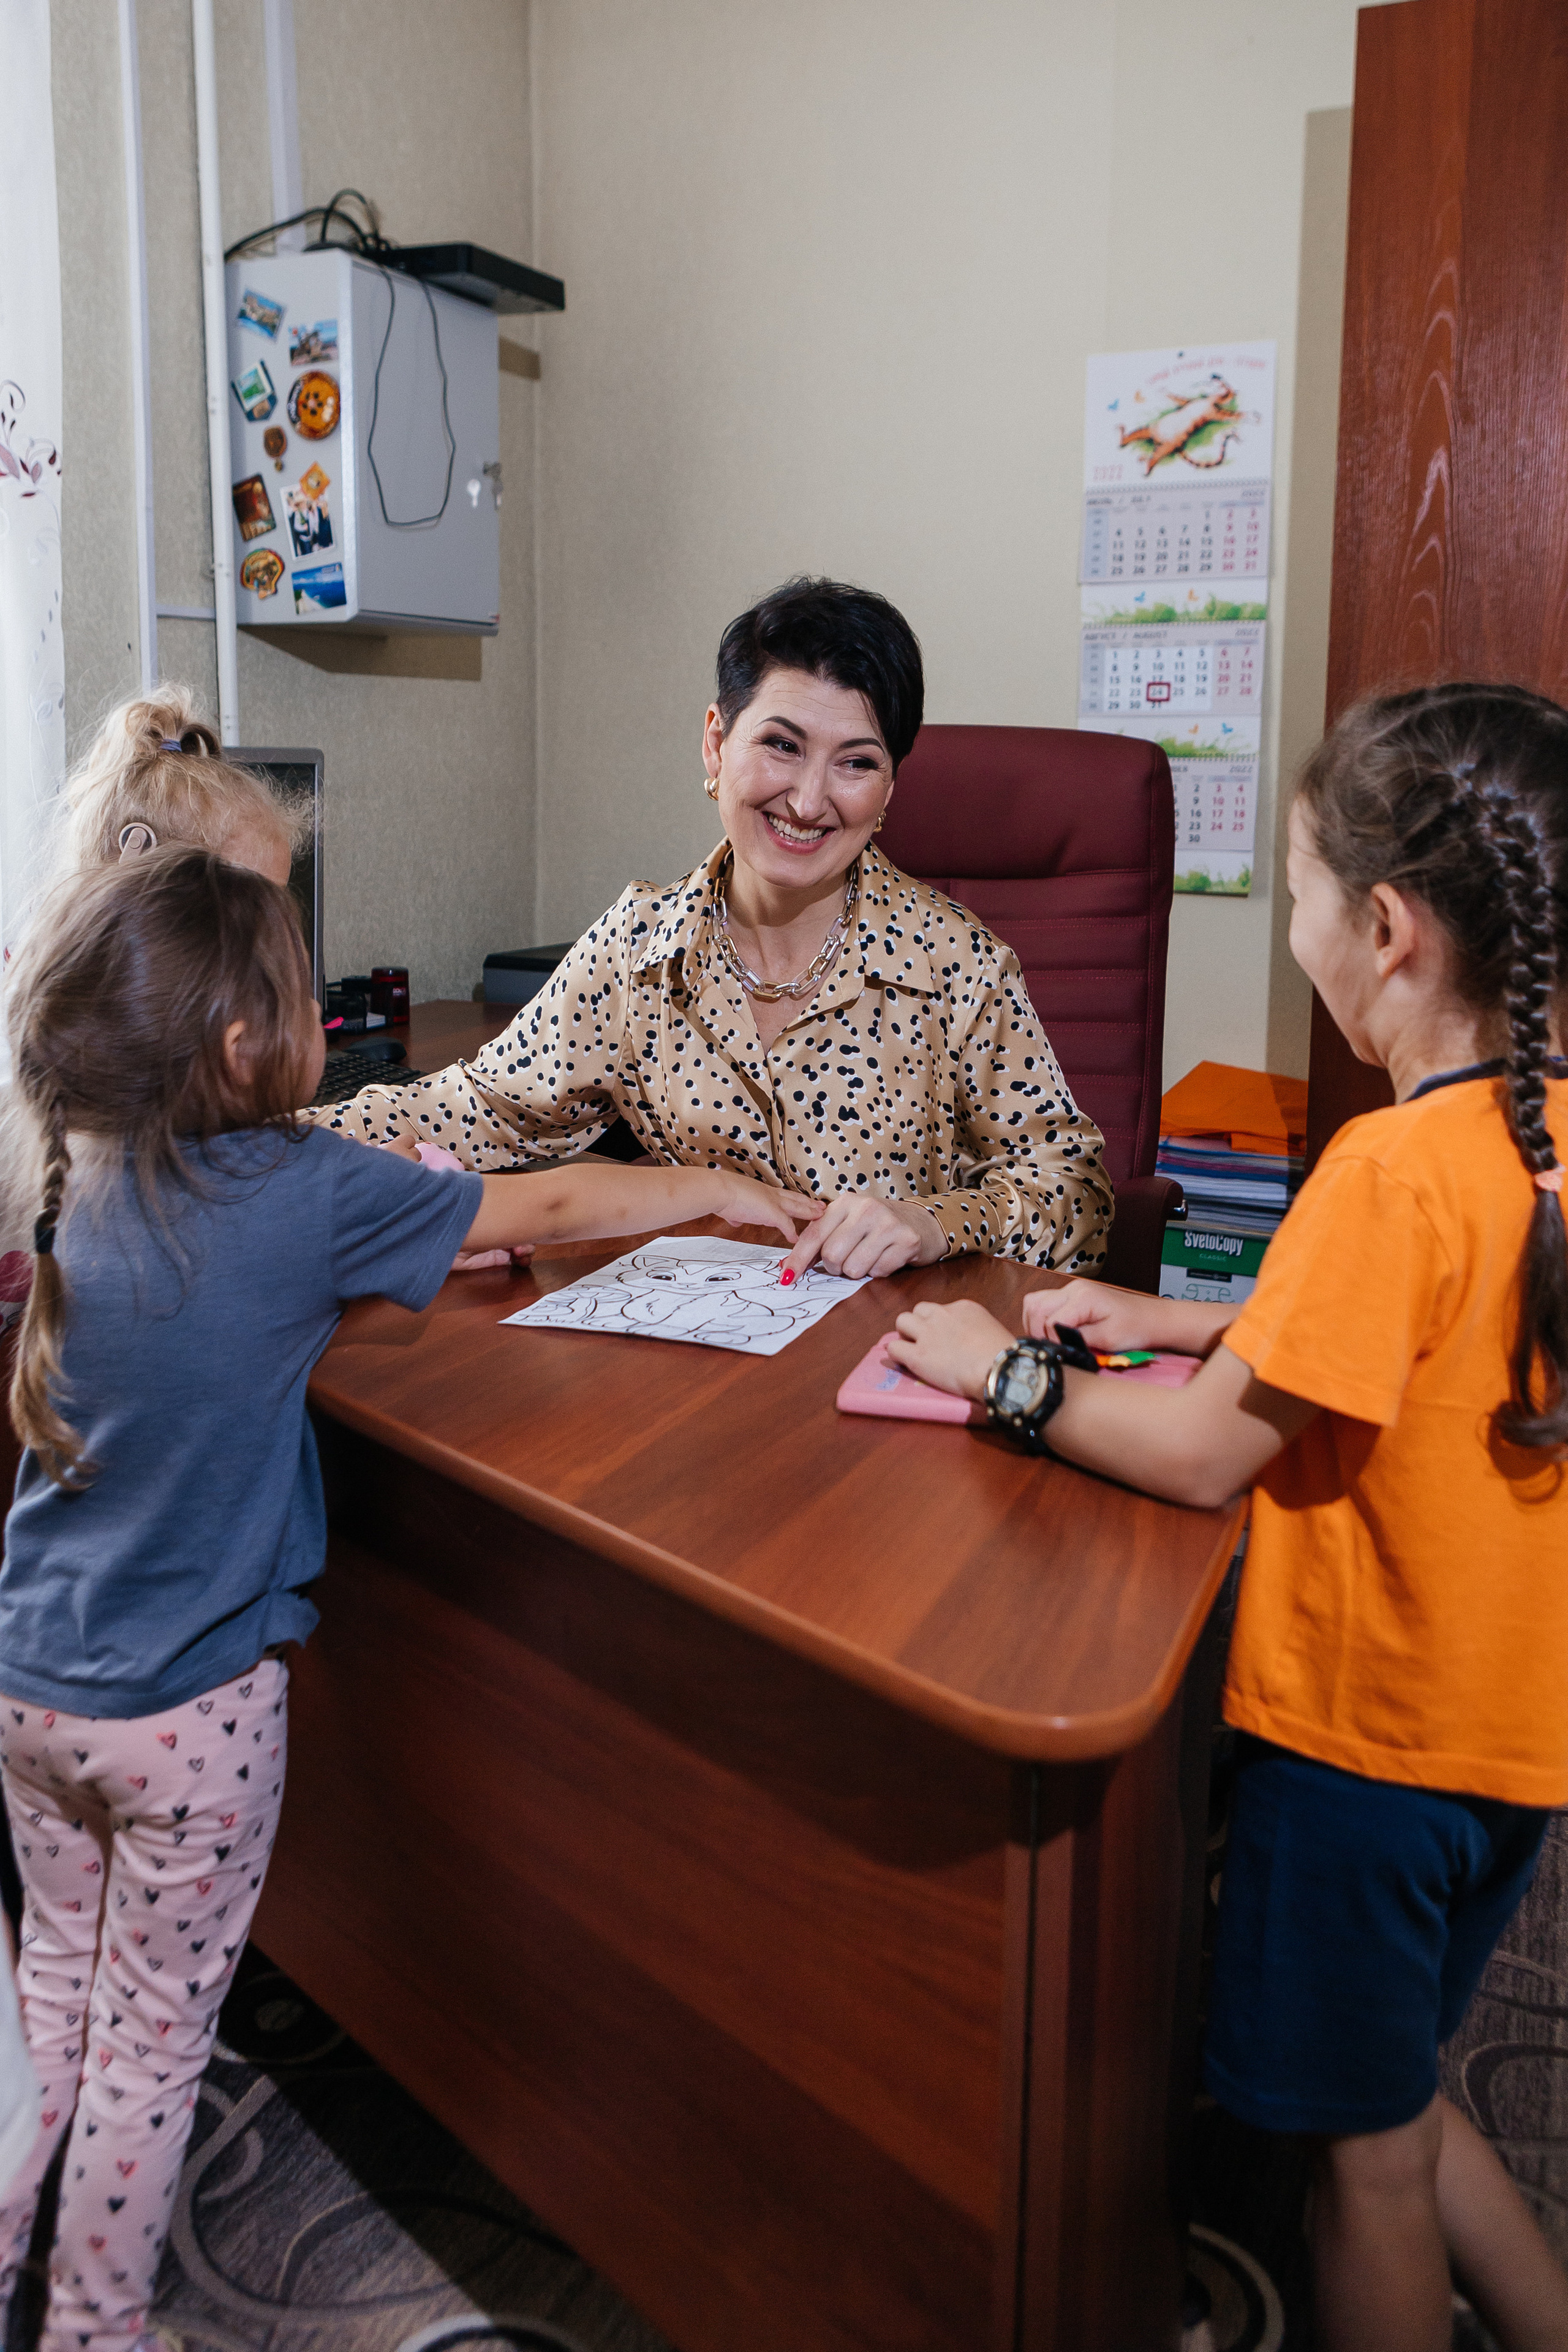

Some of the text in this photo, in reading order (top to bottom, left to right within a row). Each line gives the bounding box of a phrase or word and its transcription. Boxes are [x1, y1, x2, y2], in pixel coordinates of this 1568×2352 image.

[1193, 783, 1200, 793] 2
[1216, 783, 1223, 793] 3
[1237, 783, 1244, 793] 4
[1193, 796, 1200, 805] 9
[1213, 796, 1224, 805] 10
[1234, 796, 1246, 805] 11
[1190, 809, 1202, 818] 16
[1212, 809, 1224, 818] 17
[1234, 809, 1245, 818] 18
[1189, 821, 1201, 831] 23
[1211, 821, 1223, 831] 24
[1232, 821, 1245, 831] 25
[1188, 834, 1200, 843] 30
[1183, 1231, 1244, 1256] SvetoCopy
